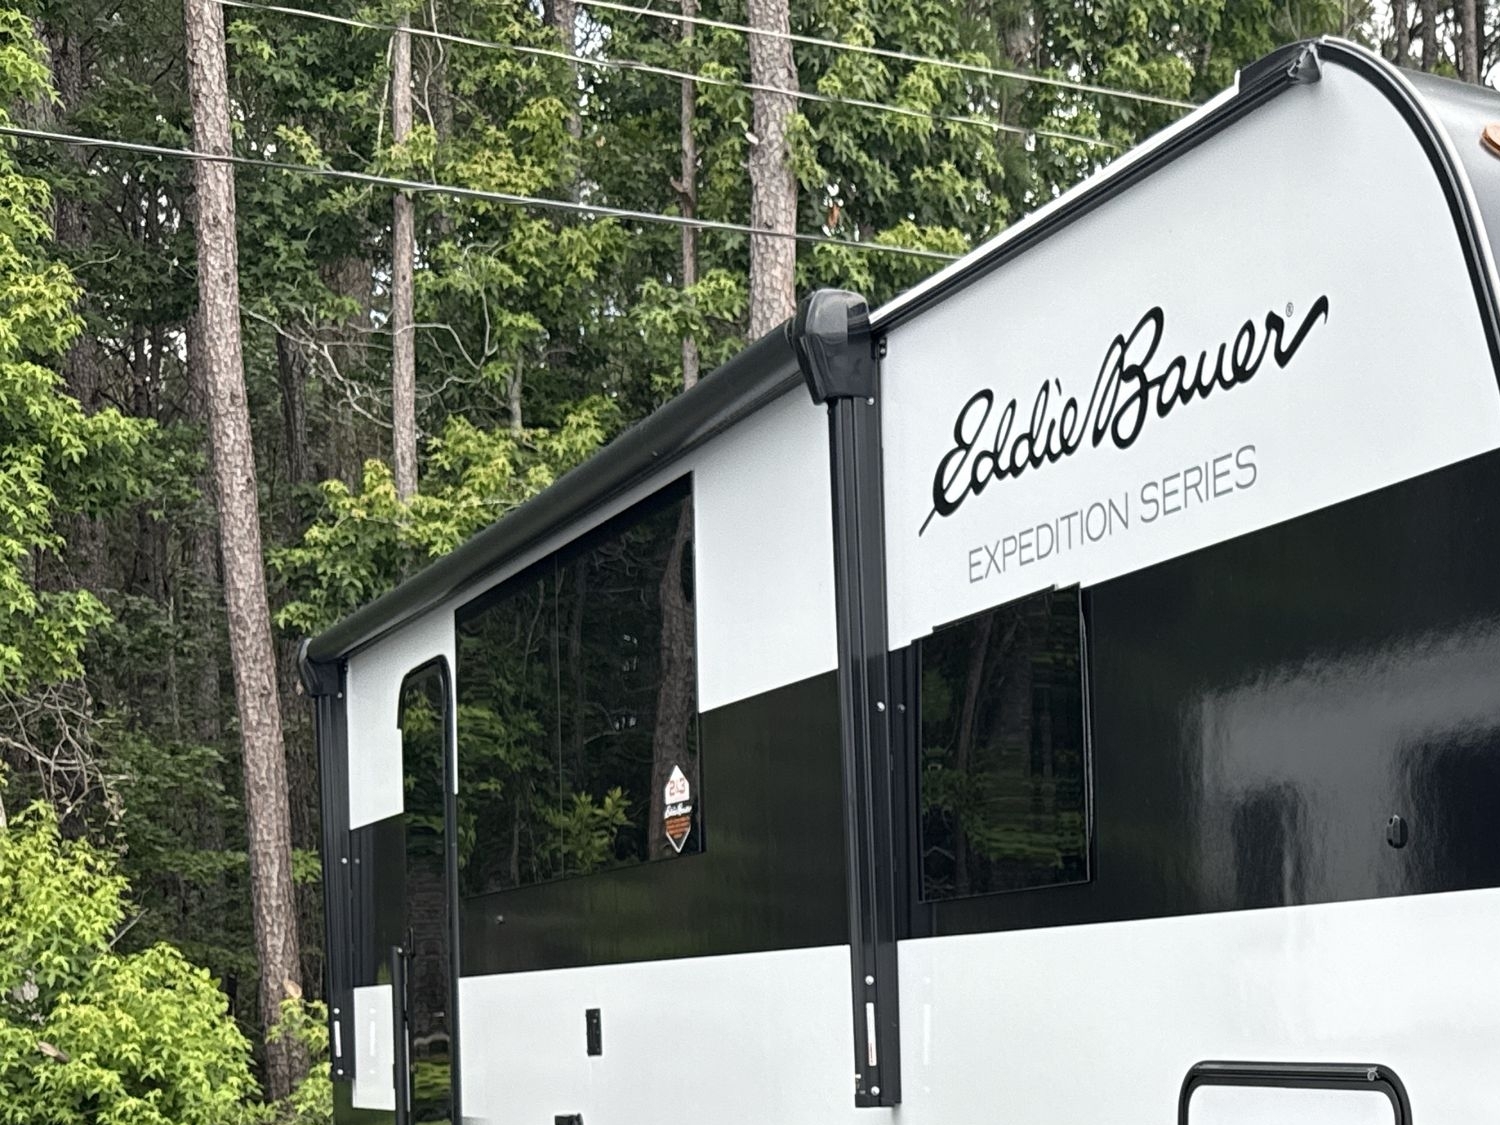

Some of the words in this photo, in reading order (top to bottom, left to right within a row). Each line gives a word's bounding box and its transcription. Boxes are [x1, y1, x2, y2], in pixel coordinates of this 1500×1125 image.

[919, 377, 1091, 536] Eddie
[1091, 295, 1329, 449] Bauer
[968, 492, 1130, 584] EXPEDITION
[1140, 444, 1258, 524] SERIES
